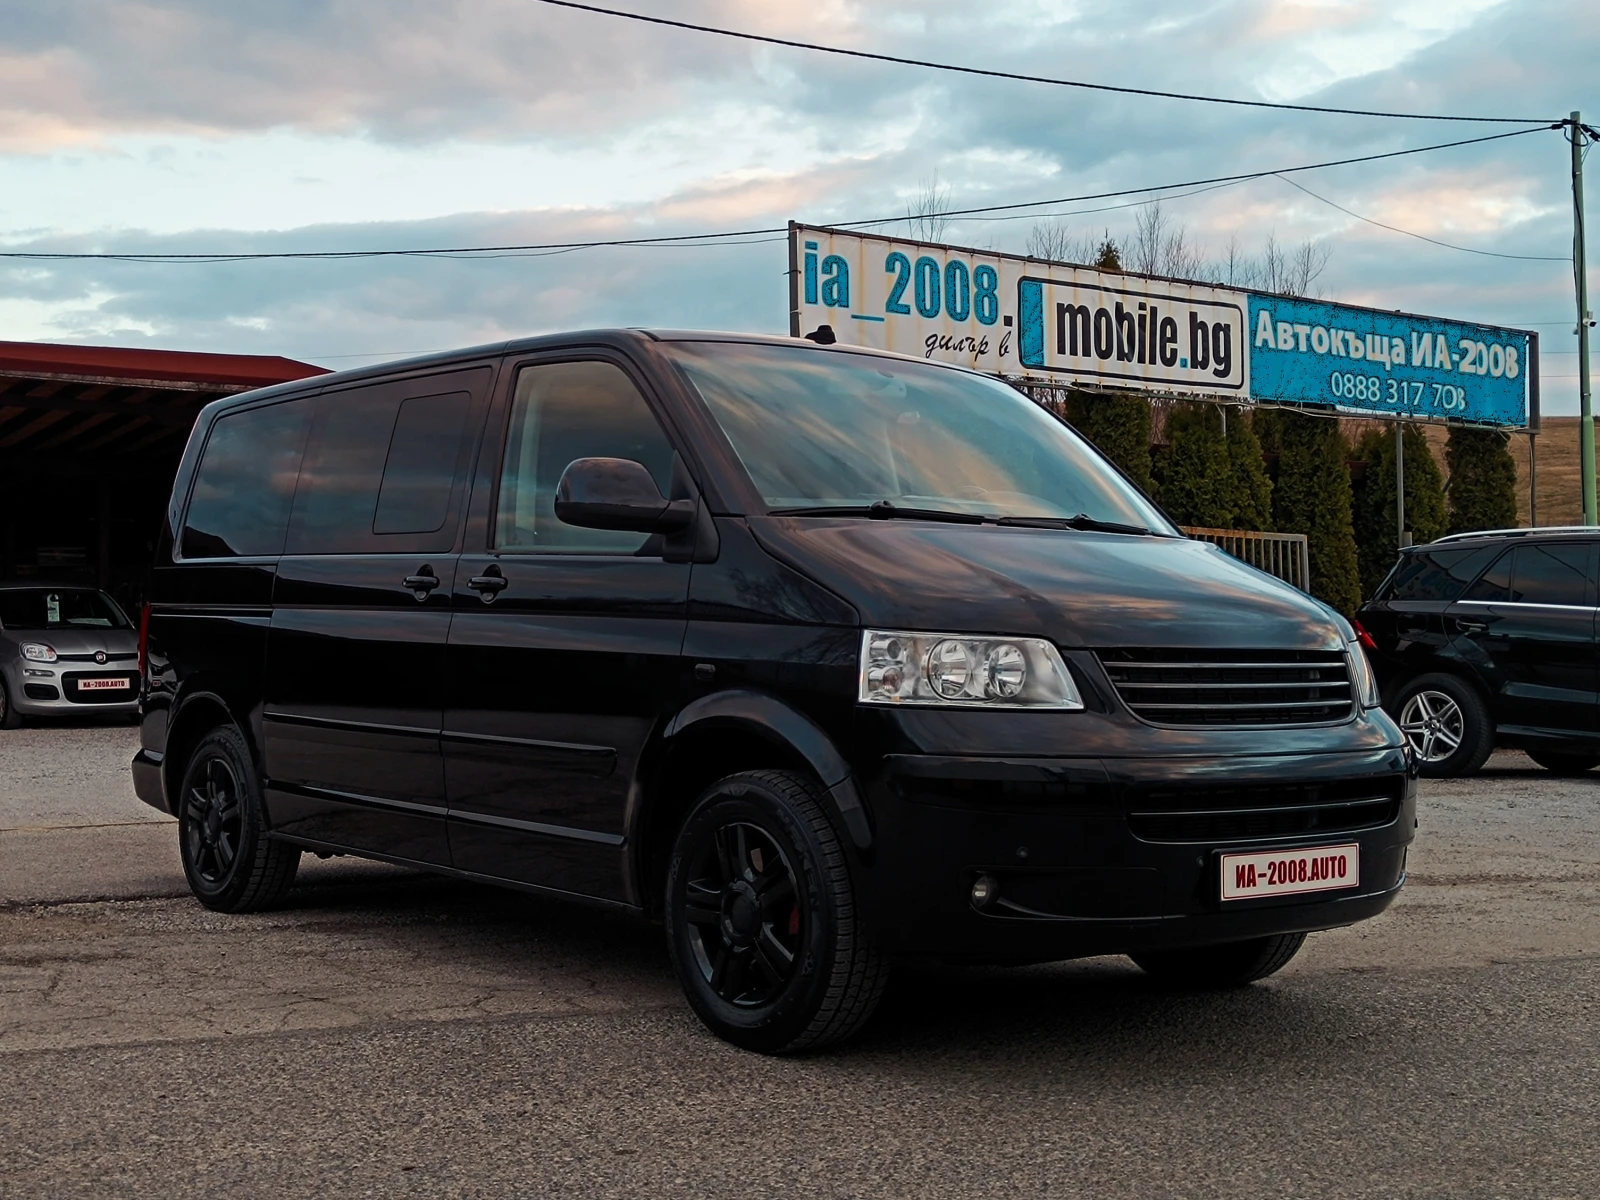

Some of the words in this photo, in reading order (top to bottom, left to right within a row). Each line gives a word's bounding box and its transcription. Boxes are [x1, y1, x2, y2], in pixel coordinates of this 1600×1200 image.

[925, 333, 989, 362] дилър
[998, 330, 1012, 357] в
[1056, 302, 1232, 378] mobile.bg
[1255, 310, 1406, 371] Автокъща
[1411, 331, 1519, 379] ИА-2008
[1331, 371, 1381, 402] 0888
[1386, 379, 1425, 406] 317
